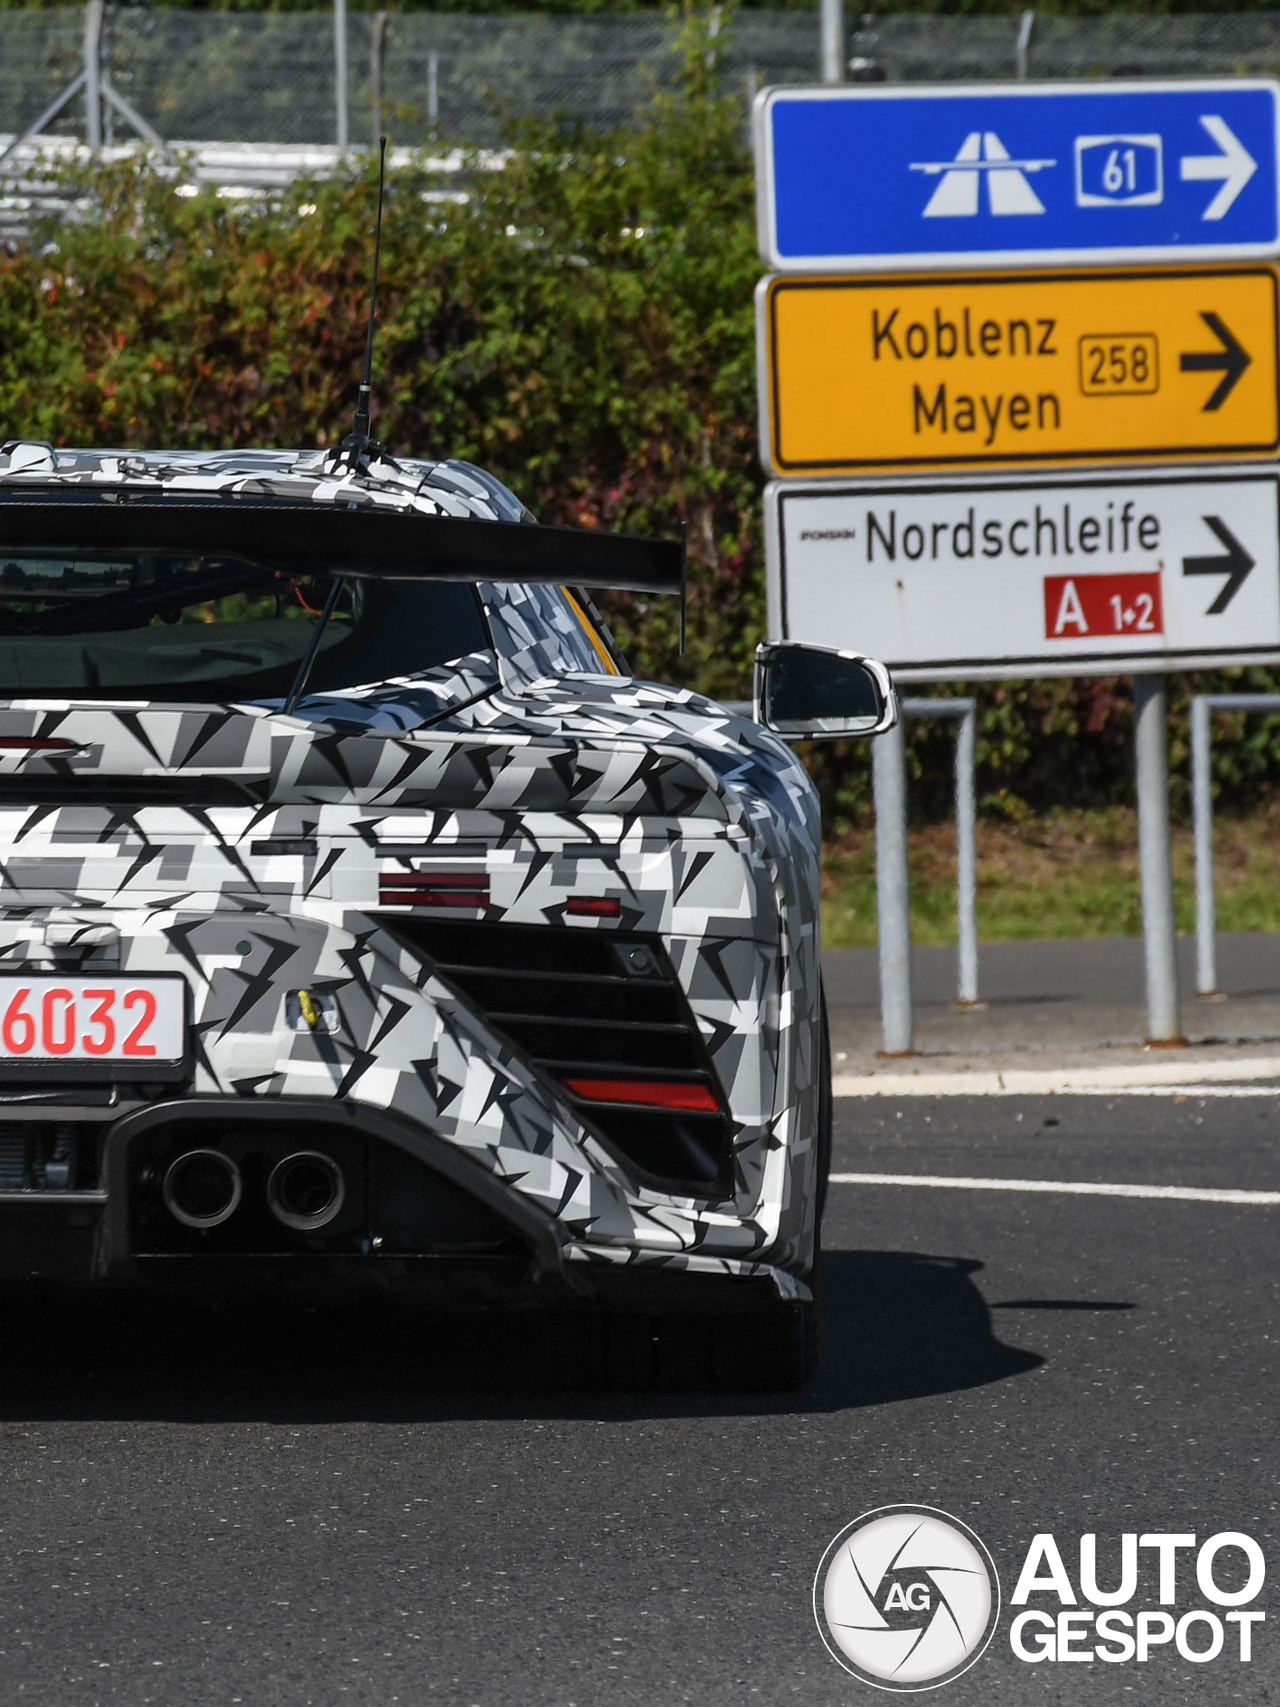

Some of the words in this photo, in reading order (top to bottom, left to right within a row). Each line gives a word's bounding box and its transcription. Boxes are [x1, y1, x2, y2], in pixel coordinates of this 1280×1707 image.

[1103, 149, 1136, 192] 61
[872, 307, 1058, 361] Koblenz
[1089, 345, 1149, 385] 258
[913, 382, 1061, 446] Mayen
[866, 501, 1161, 563] Nordschleife
[1054, 579, 1089, 634] A
